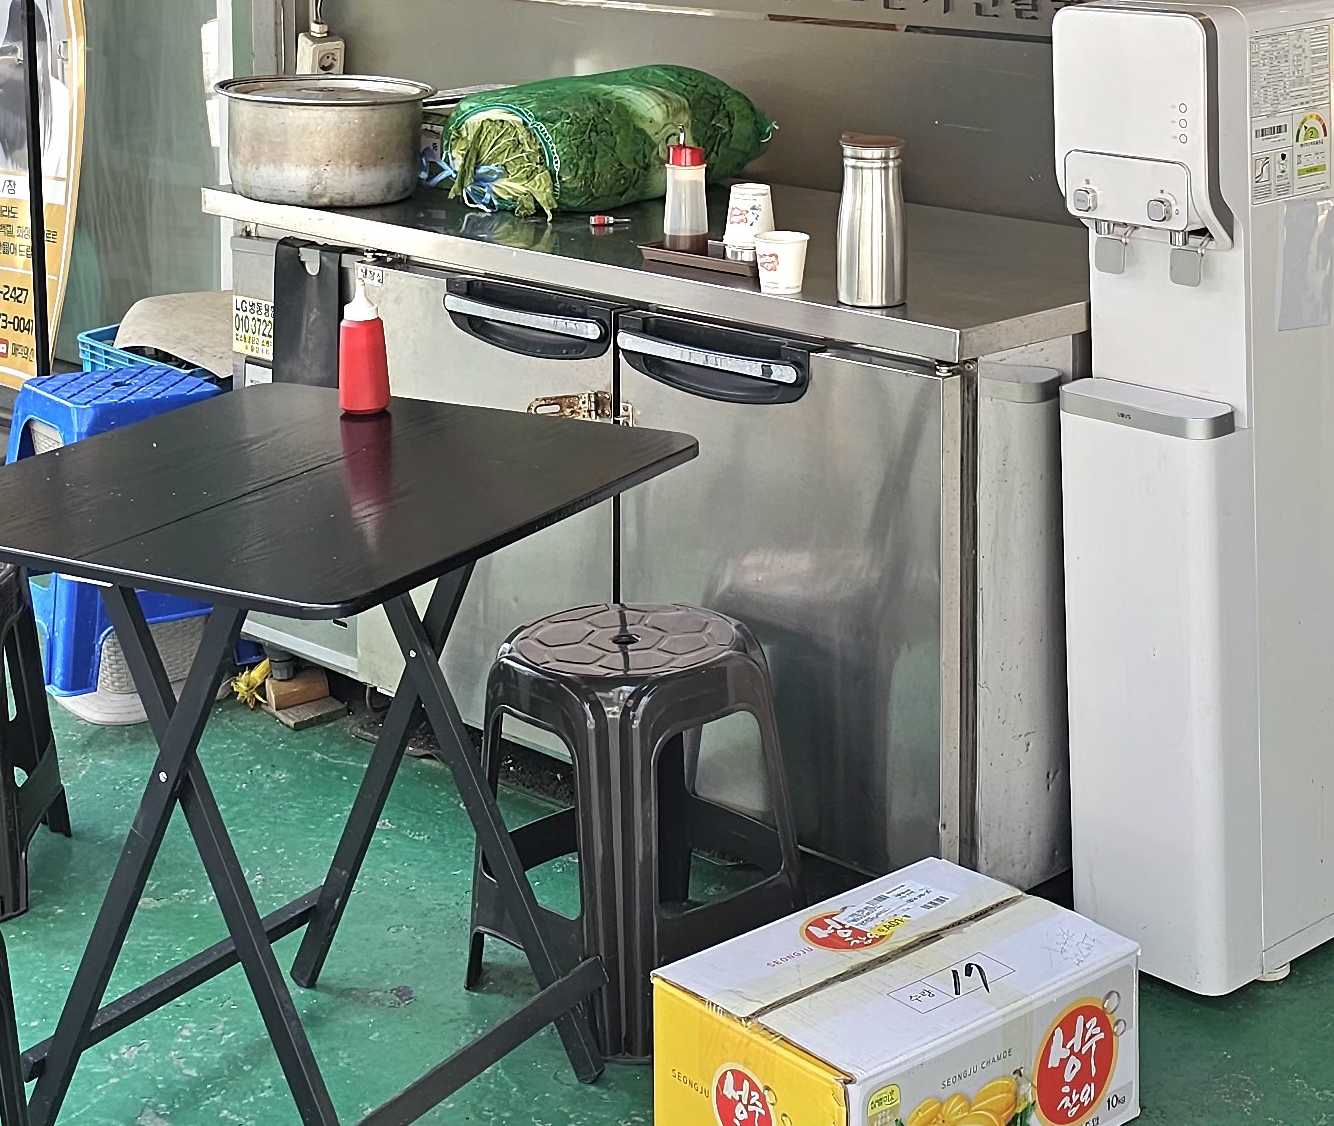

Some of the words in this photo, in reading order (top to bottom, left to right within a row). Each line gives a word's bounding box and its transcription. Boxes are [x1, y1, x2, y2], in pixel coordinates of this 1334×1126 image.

[234, 313, 250, 334] 010
[250, 316, 273, 339] 3722
[765, 945, 814, 970] SEONGJU
[908, 988, 937, 1004] 수량
[1048, 1013, 1105, 1082] 성주
[670, 1067, 711, 1100] SEONGJU
[940, 1064, 979, 1090] SEONGJU
[979, 1047, 1014, 1071] CHAMOE
[721, 1070, 766, 1119] 성주
[1057, 1081, 1097, 1118] 참외
[1105, 1093, 1127, 1111] 10kg
